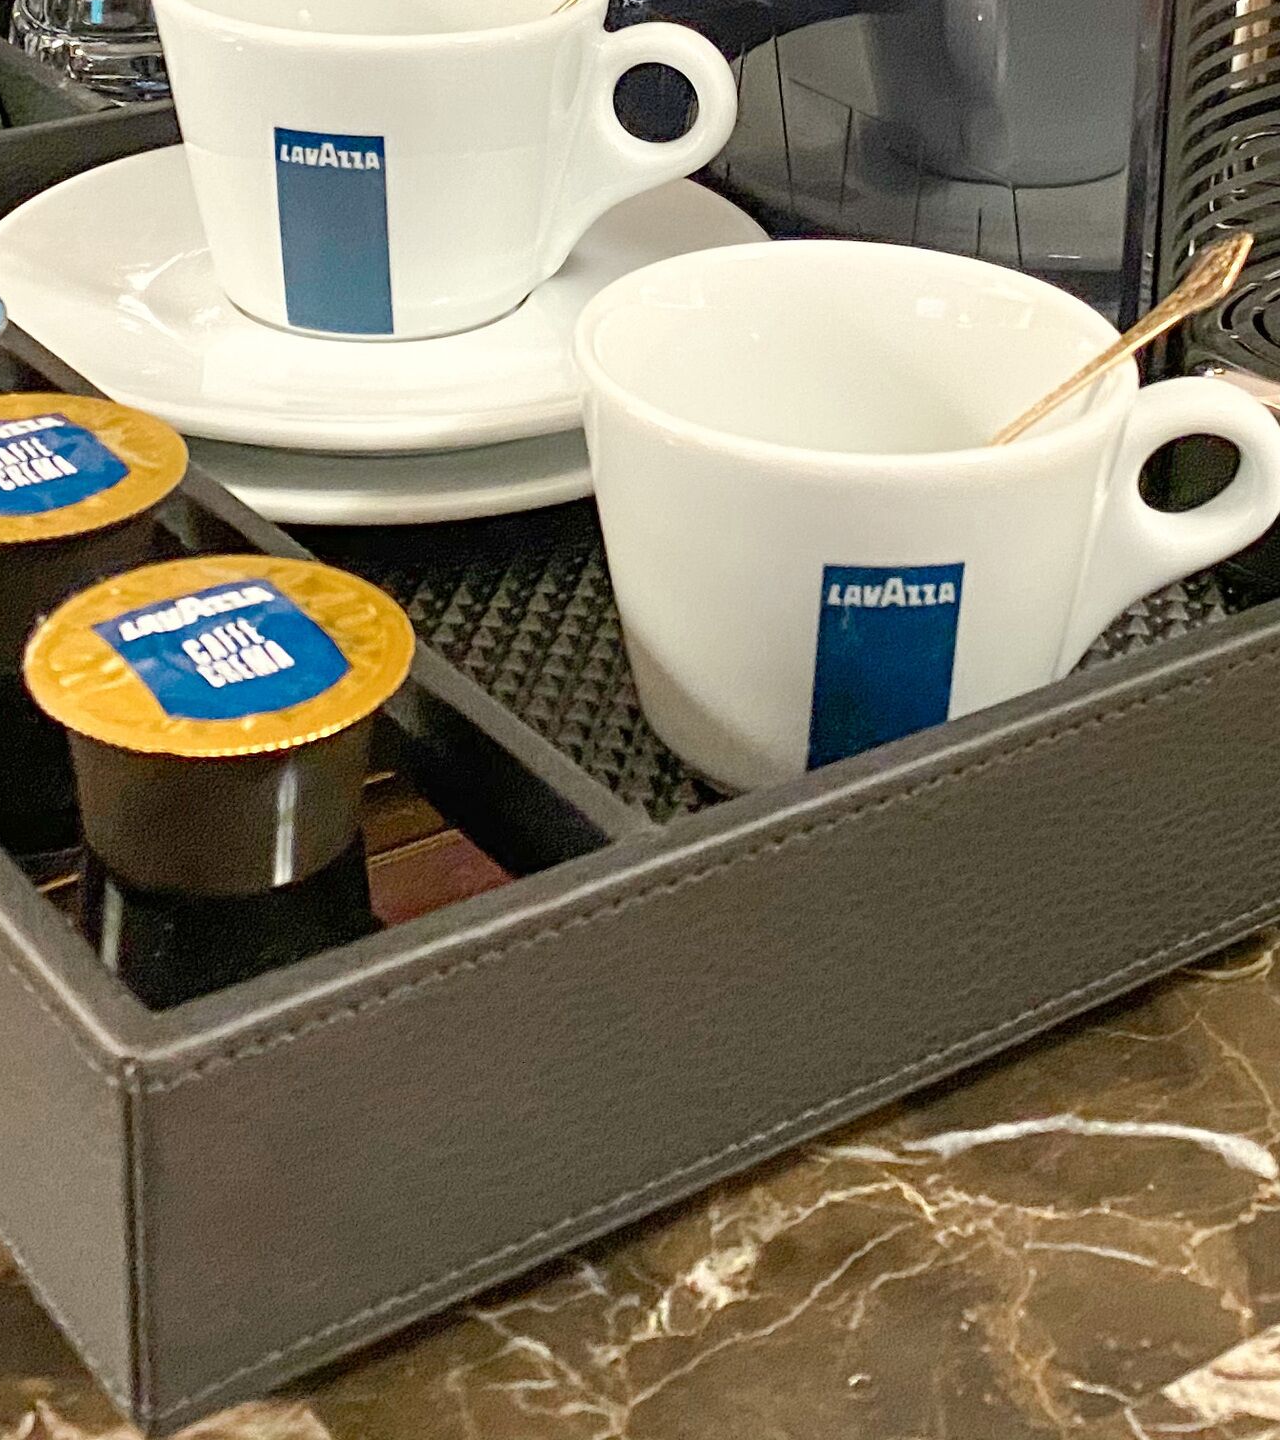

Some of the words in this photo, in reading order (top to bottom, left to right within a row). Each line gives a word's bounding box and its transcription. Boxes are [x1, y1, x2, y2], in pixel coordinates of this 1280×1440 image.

[280, 142, 380, 170] LAVAZZA
[827, 577, 955, 608] LAVAZZA
[119, 586, 276, 642] LAVAZZA
[196, 639, 296, 688] CREMA
